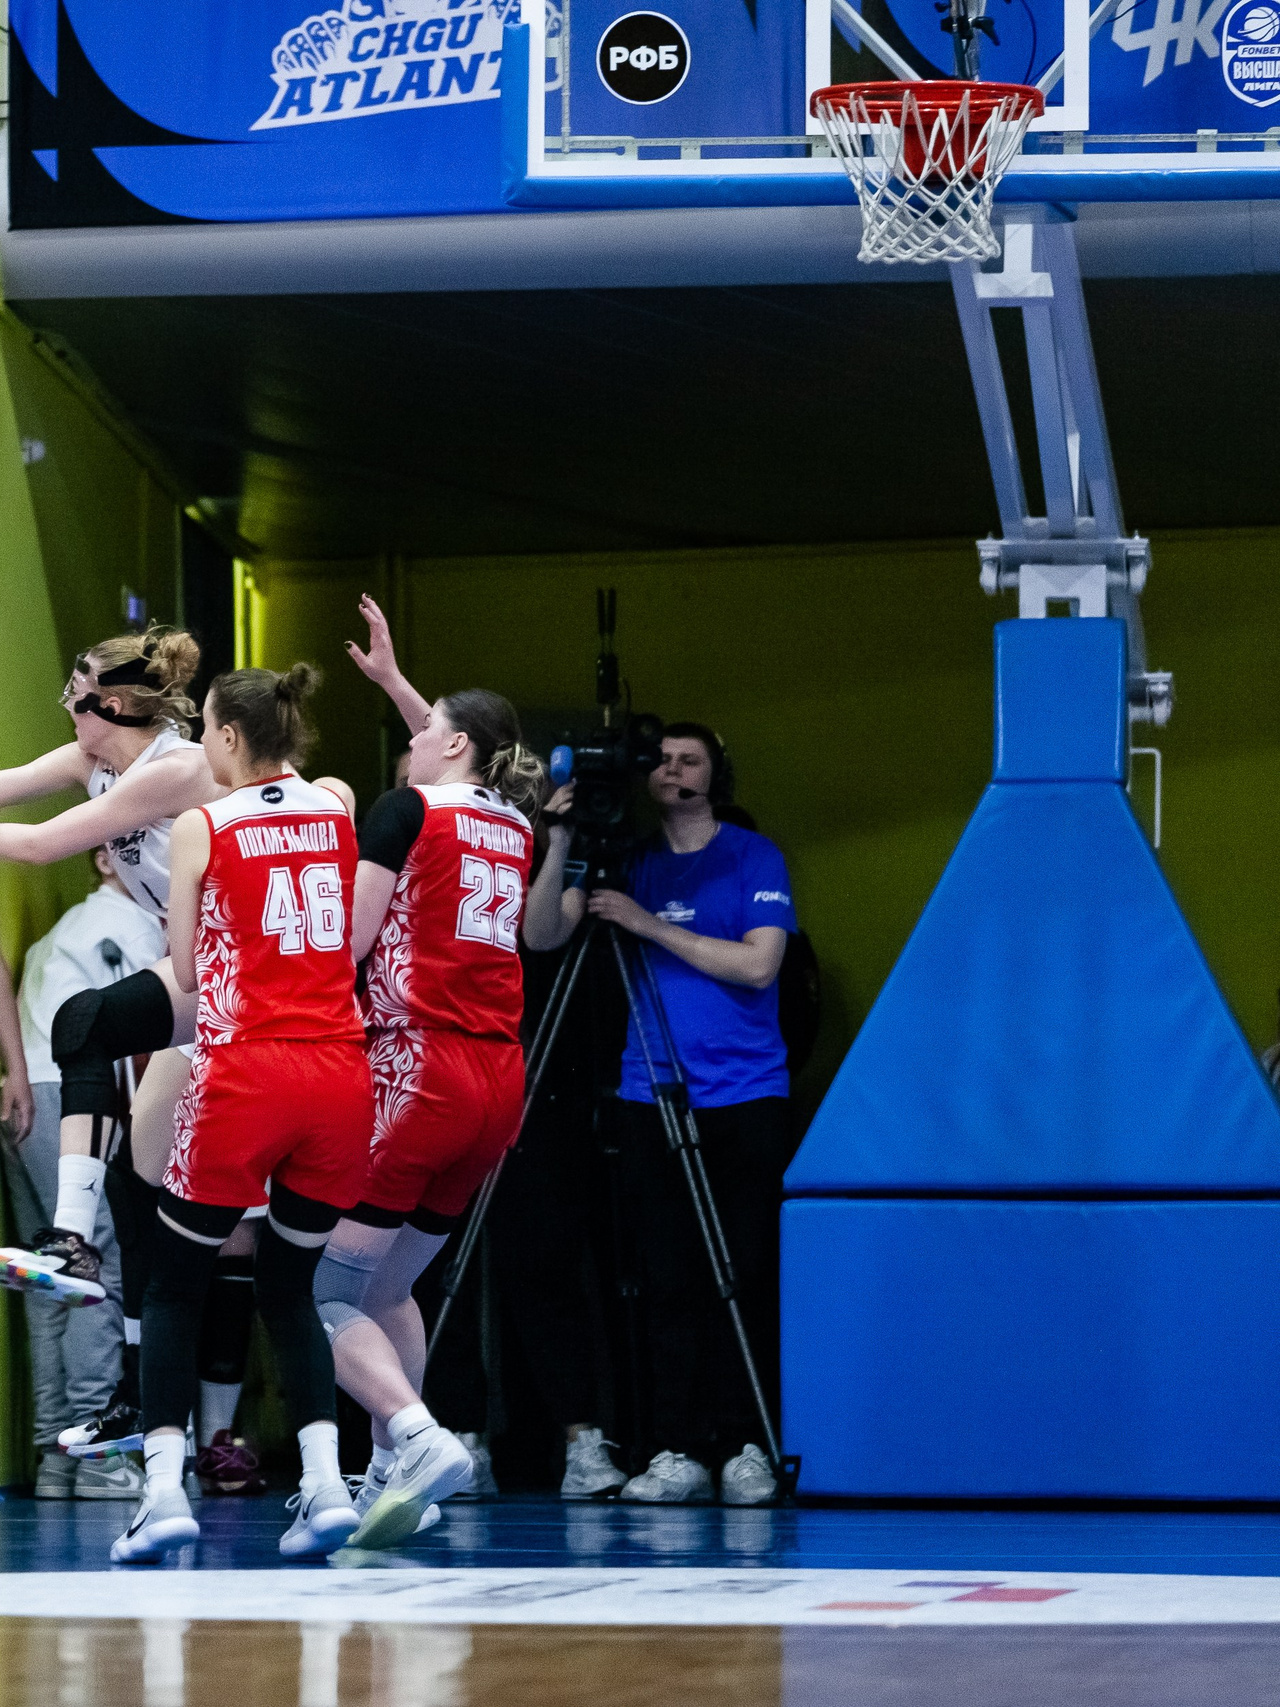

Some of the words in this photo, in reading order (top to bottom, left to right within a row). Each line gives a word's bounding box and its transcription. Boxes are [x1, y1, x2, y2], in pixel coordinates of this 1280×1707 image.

[347, 13, 484, 62] CHGU
[608, 44, 680, 72] РФБ
[261, 862, 345, 955] 46
[455, 853, 523, 954] 22
